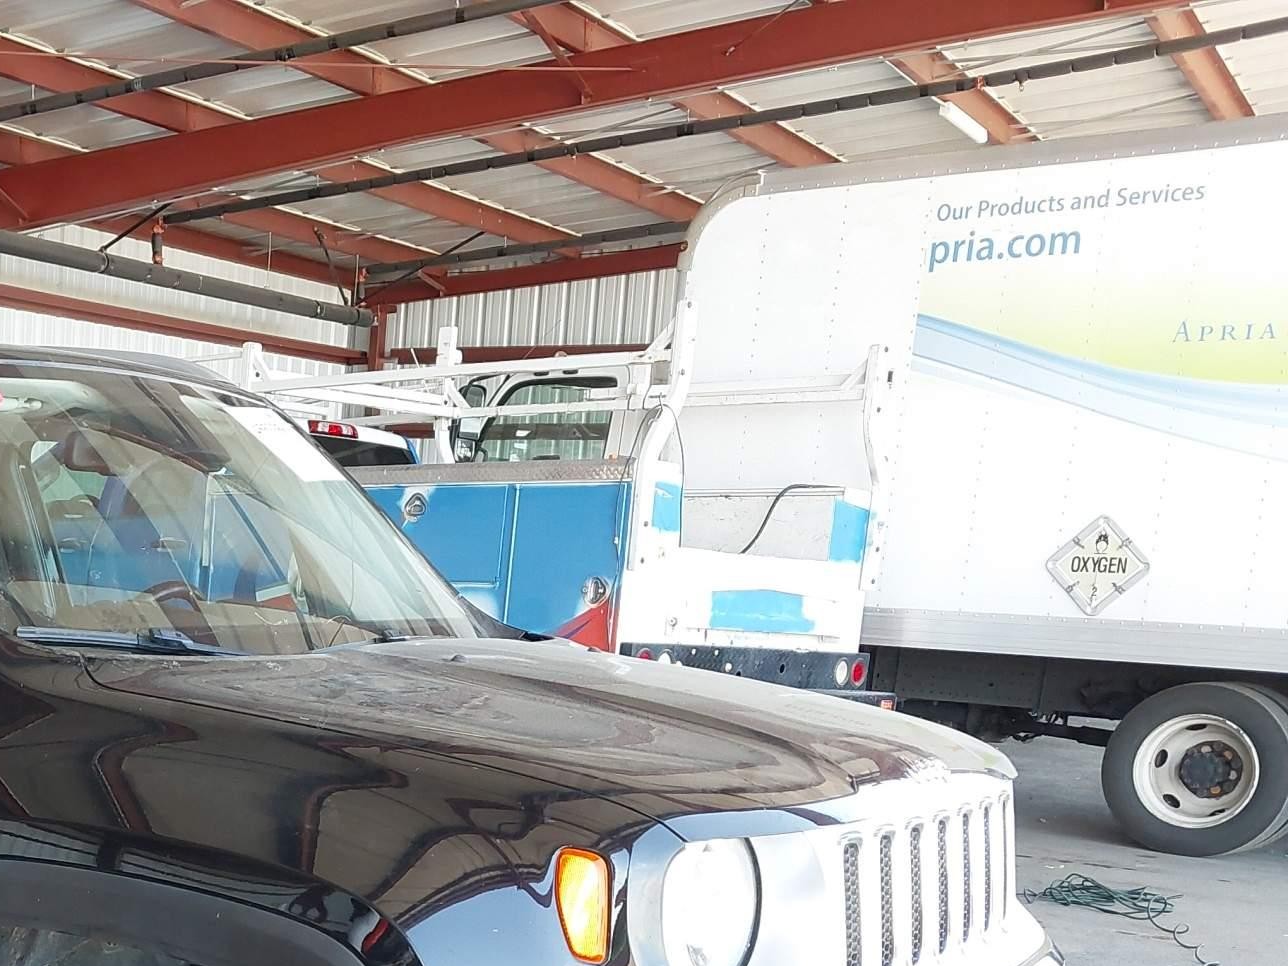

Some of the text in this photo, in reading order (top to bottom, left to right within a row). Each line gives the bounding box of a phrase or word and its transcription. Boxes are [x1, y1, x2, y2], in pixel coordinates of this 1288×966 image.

[936, 183, 1206, 222] Our Products and Services
[928, 229, 1082, 272] pria.com
[1172, 320, 1276, 343] APRIA
[1071, 555, 1128, 574] OXYGEN
